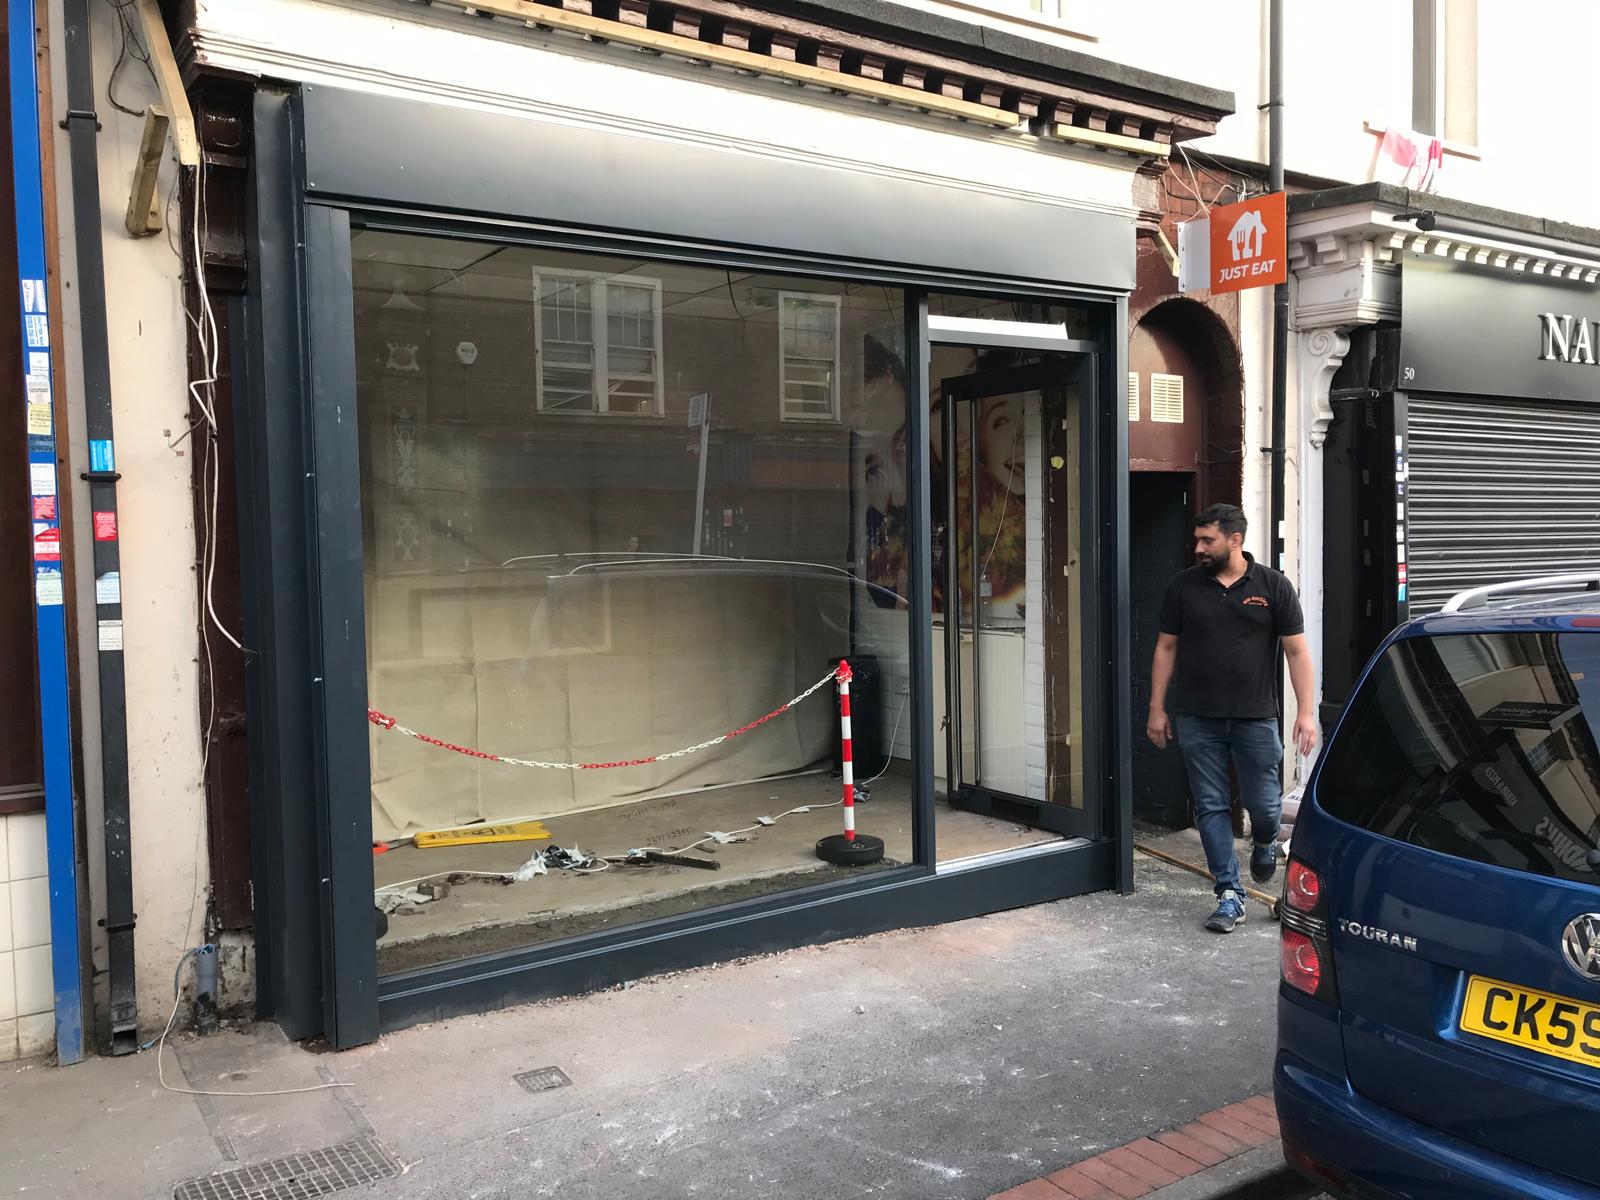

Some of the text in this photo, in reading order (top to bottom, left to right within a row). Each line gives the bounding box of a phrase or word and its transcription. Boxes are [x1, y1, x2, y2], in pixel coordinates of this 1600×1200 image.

[1219, 259, 1276, 283] JUST EAT
[1545, 312, 1600, 365] NA
[1404, 367, 1415, 380] 50
[1338, 917, 1418, 952] TOURAN
